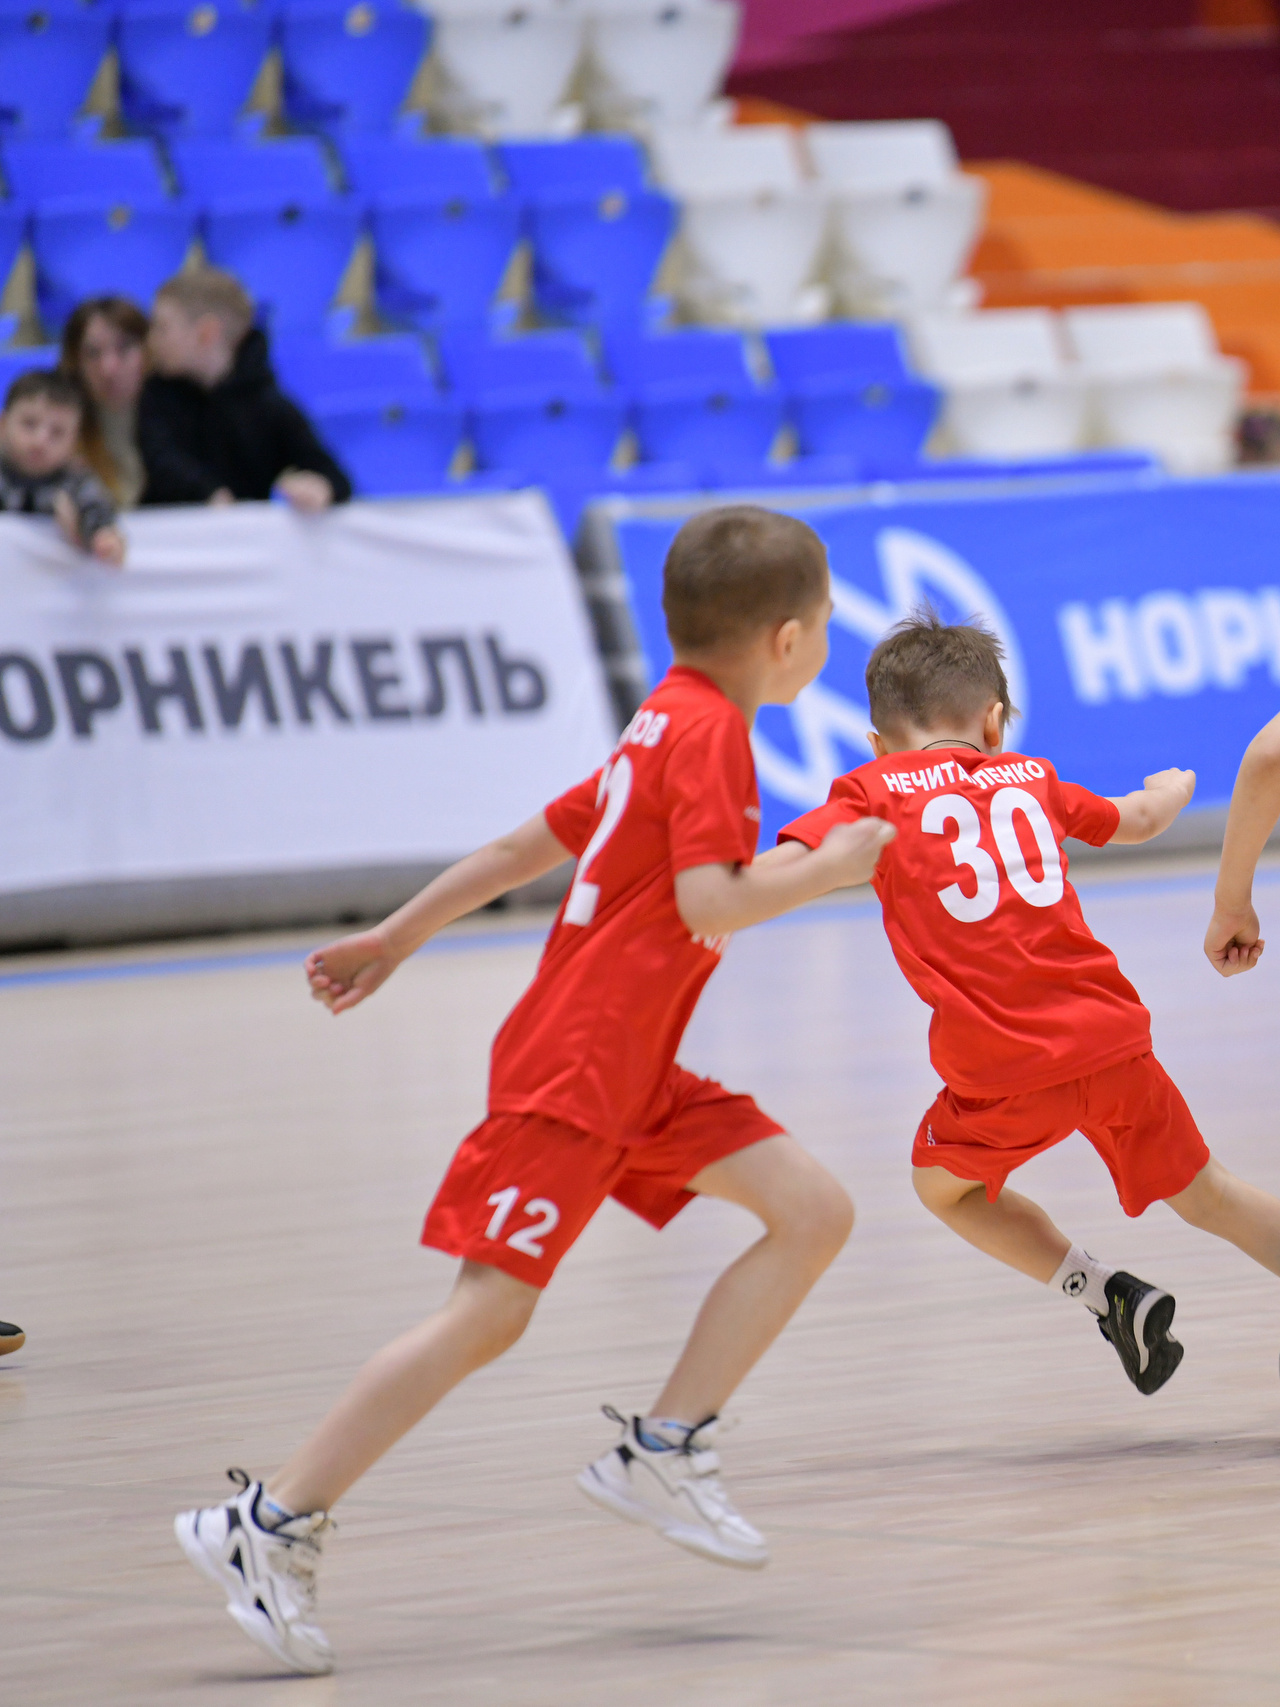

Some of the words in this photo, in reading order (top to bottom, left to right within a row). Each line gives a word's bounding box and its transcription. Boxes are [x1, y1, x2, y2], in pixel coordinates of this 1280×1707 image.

[881, 760, 1046, 793] НЕЧИТАЛЕНКО
[921, 787, 1063, 923] 30
[484, 1185, 559, 1259] 12
